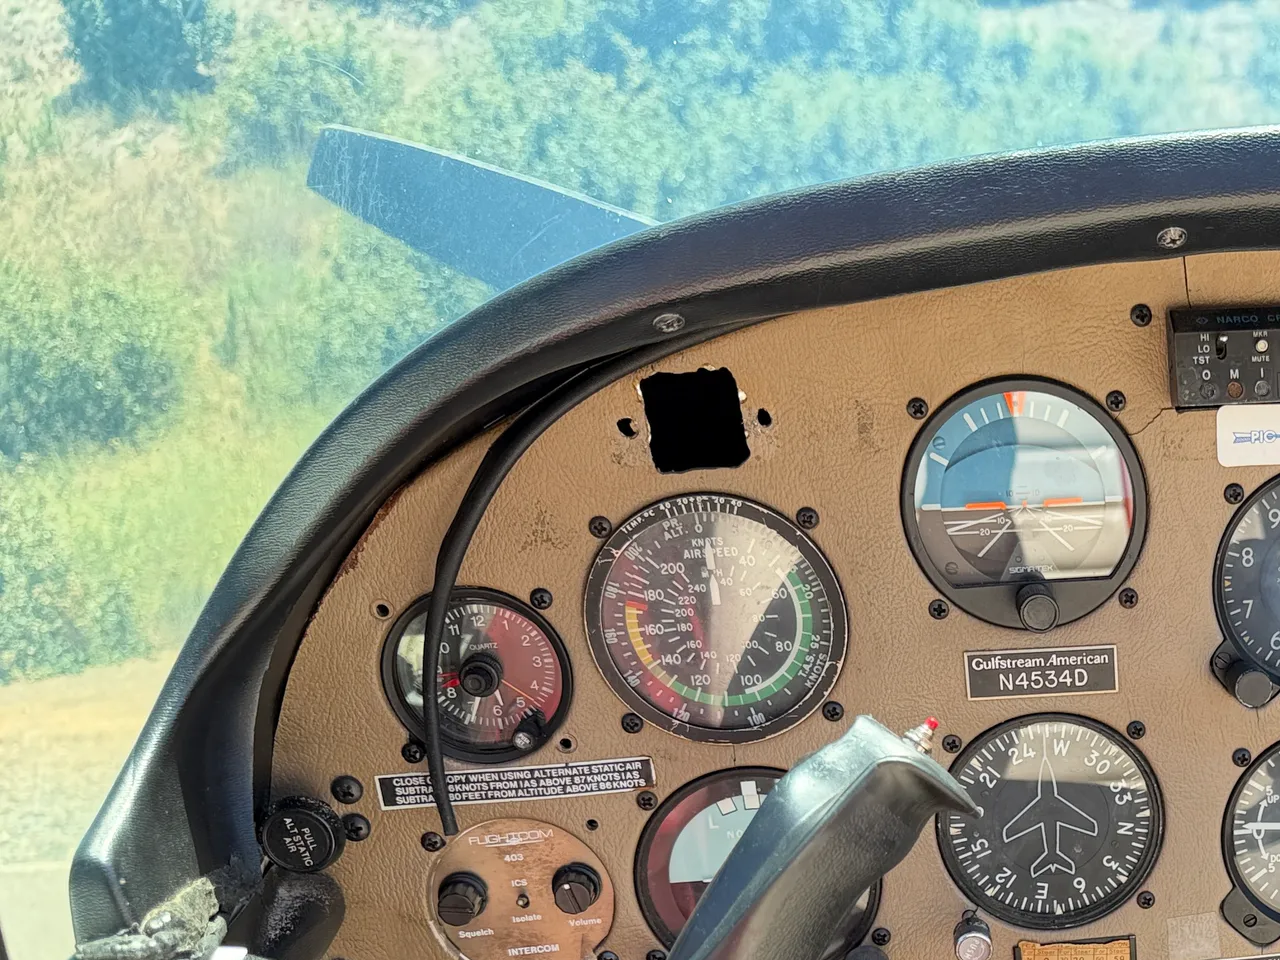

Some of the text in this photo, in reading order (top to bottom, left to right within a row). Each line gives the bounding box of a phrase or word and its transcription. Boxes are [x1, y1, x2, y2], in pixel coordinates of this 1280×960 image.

[1216, 315, 1258, 324] NARCO
[691, 537, 724, 547] KNOTS
[683, 547, 738, 559] AIRSPEED
[660, 563, 685, 575] 200
[644, 590, 664, 602] 180
[771, 587, 787, 599] 60
[645, 623, 664, 635] 160
[469, 642, 498, 650] QUARTZ
[775, 641, 792, 653] 80
[661, 653, 681, 664] 140
[972, 653, 1109, 671] Gulfstream American
[690, 674, 711, 686] 120
[740, 674, 762, 686] 100
[999, 668, 1090, 691] N4534D
[393, 761, 642, 787] CLOSE WHEN USING ALTERNATE STATIC AIR
[301, 828, 319, 851] PULL
[293, 835, 314, 868] STATIC
[504, 853, 524, 862] 403
[511, 879, 528, 887] ICS
[512, 913, 542, 923] Isolate
[569, 916, 602, 926] Volume
[458, 928, 495, 940] Squelch
[508, 943, 560, 956] INTERCOM
